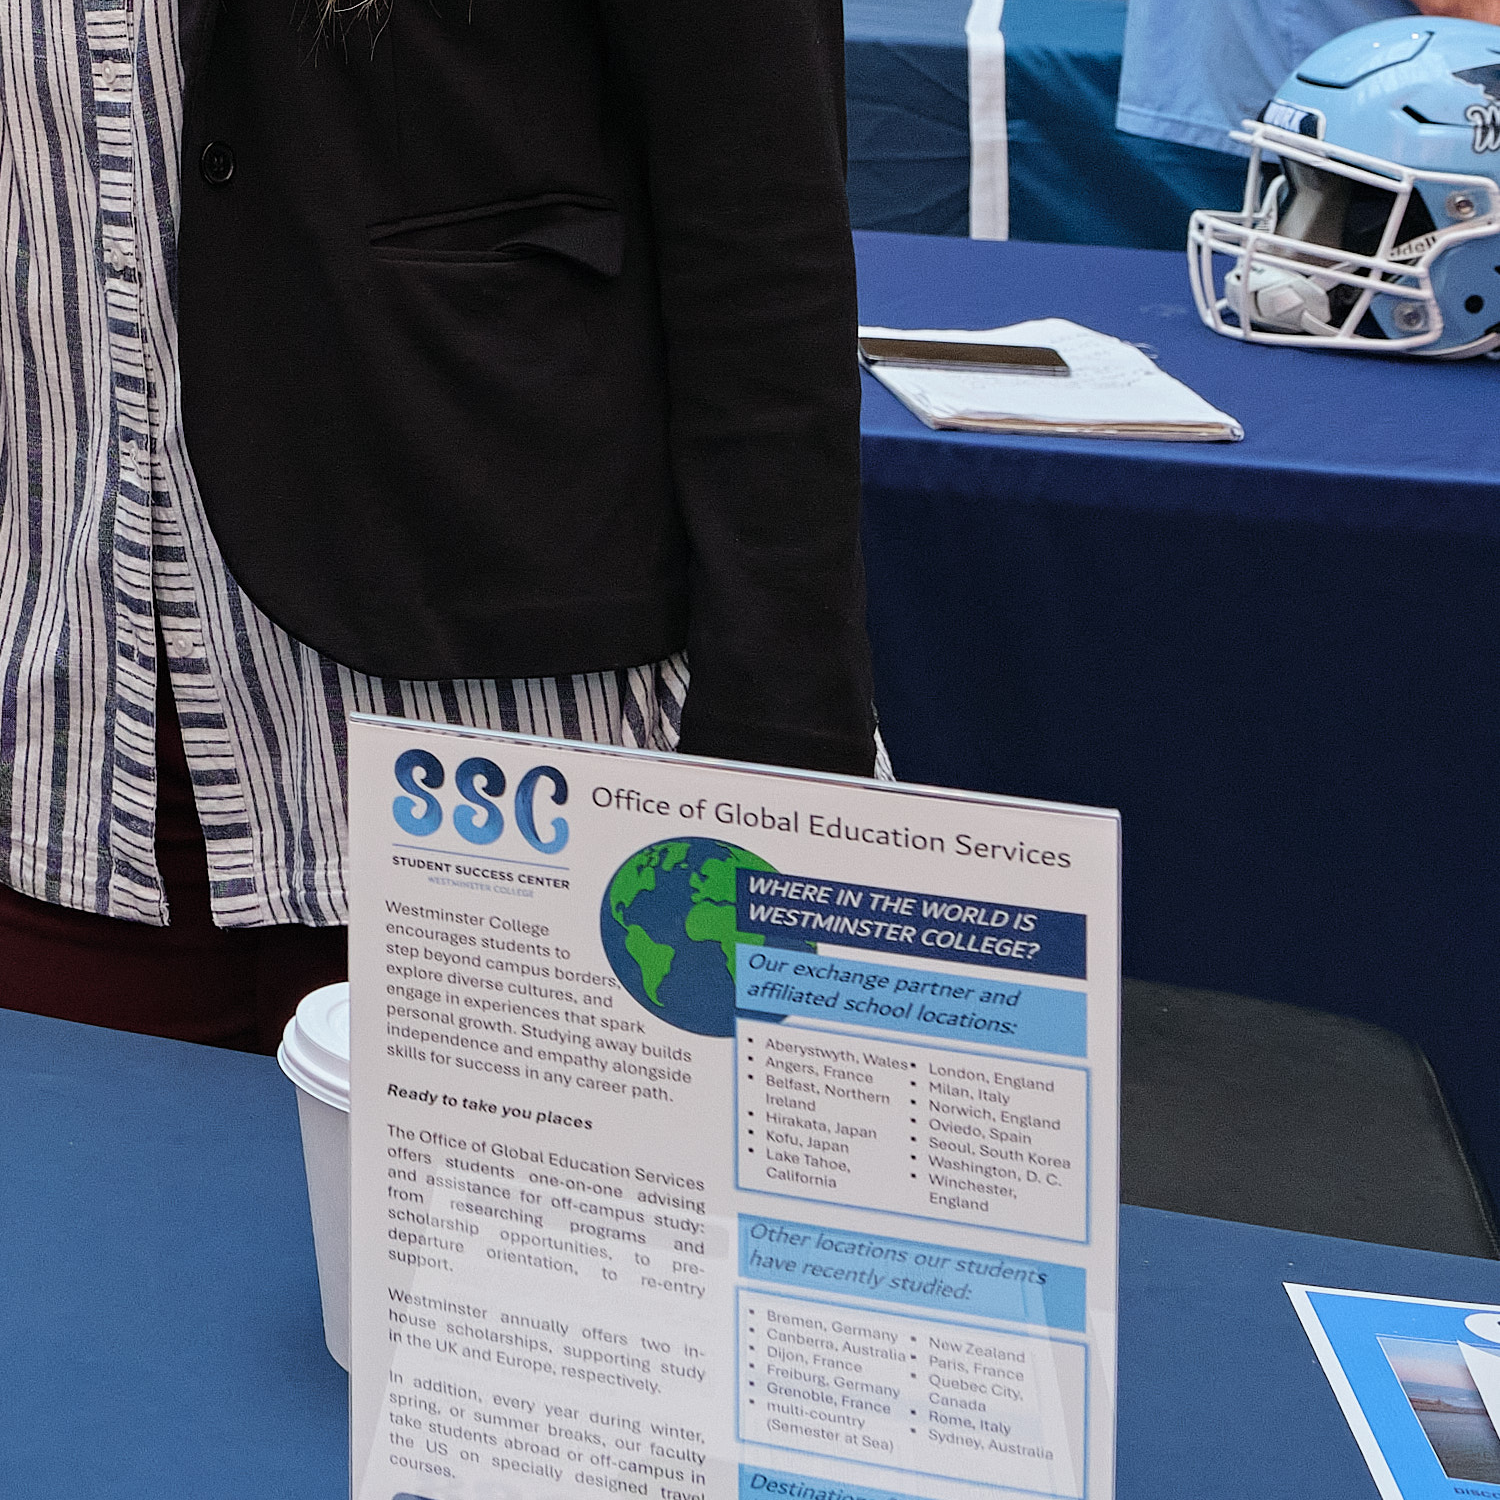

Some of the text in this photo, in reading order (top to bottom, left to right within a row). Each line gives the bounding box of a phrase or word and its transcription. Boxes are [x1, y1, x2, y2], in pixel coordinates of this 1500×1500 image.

[392, 749, 570, 855] SSC
[592, 786, 1071, 868] Office of Global Education Services
[392, 855, 452, 873] STUDENT
[455, 865, 514, 882] SUCCESS
[517, 874, 570, 890] CENTER
[749, 876, 1038, 932] WHERE IN THE WORLD IS
[749, 903, 1041, 960] WESTMINSTER COLLEGE?
[749, 954, 1022, 1007] Our exchange partner and
[748, 986, 1018, 1035] affiliated school locations:
[765, 1038, 909, 1070] Aberystwyth, Wales
[765, 1055, 873, 1084] Angers, France
[928, 1062, 1055, 1093] London, England
[929, 1081, 1011, 1107] Milan, Italy
[387, 1083, 593, 1130] Ready to take you places
[766, 1111, 877, 1140] Hirakata, Japan
[928, 1410, 1011, 1437] Rome, Italy
